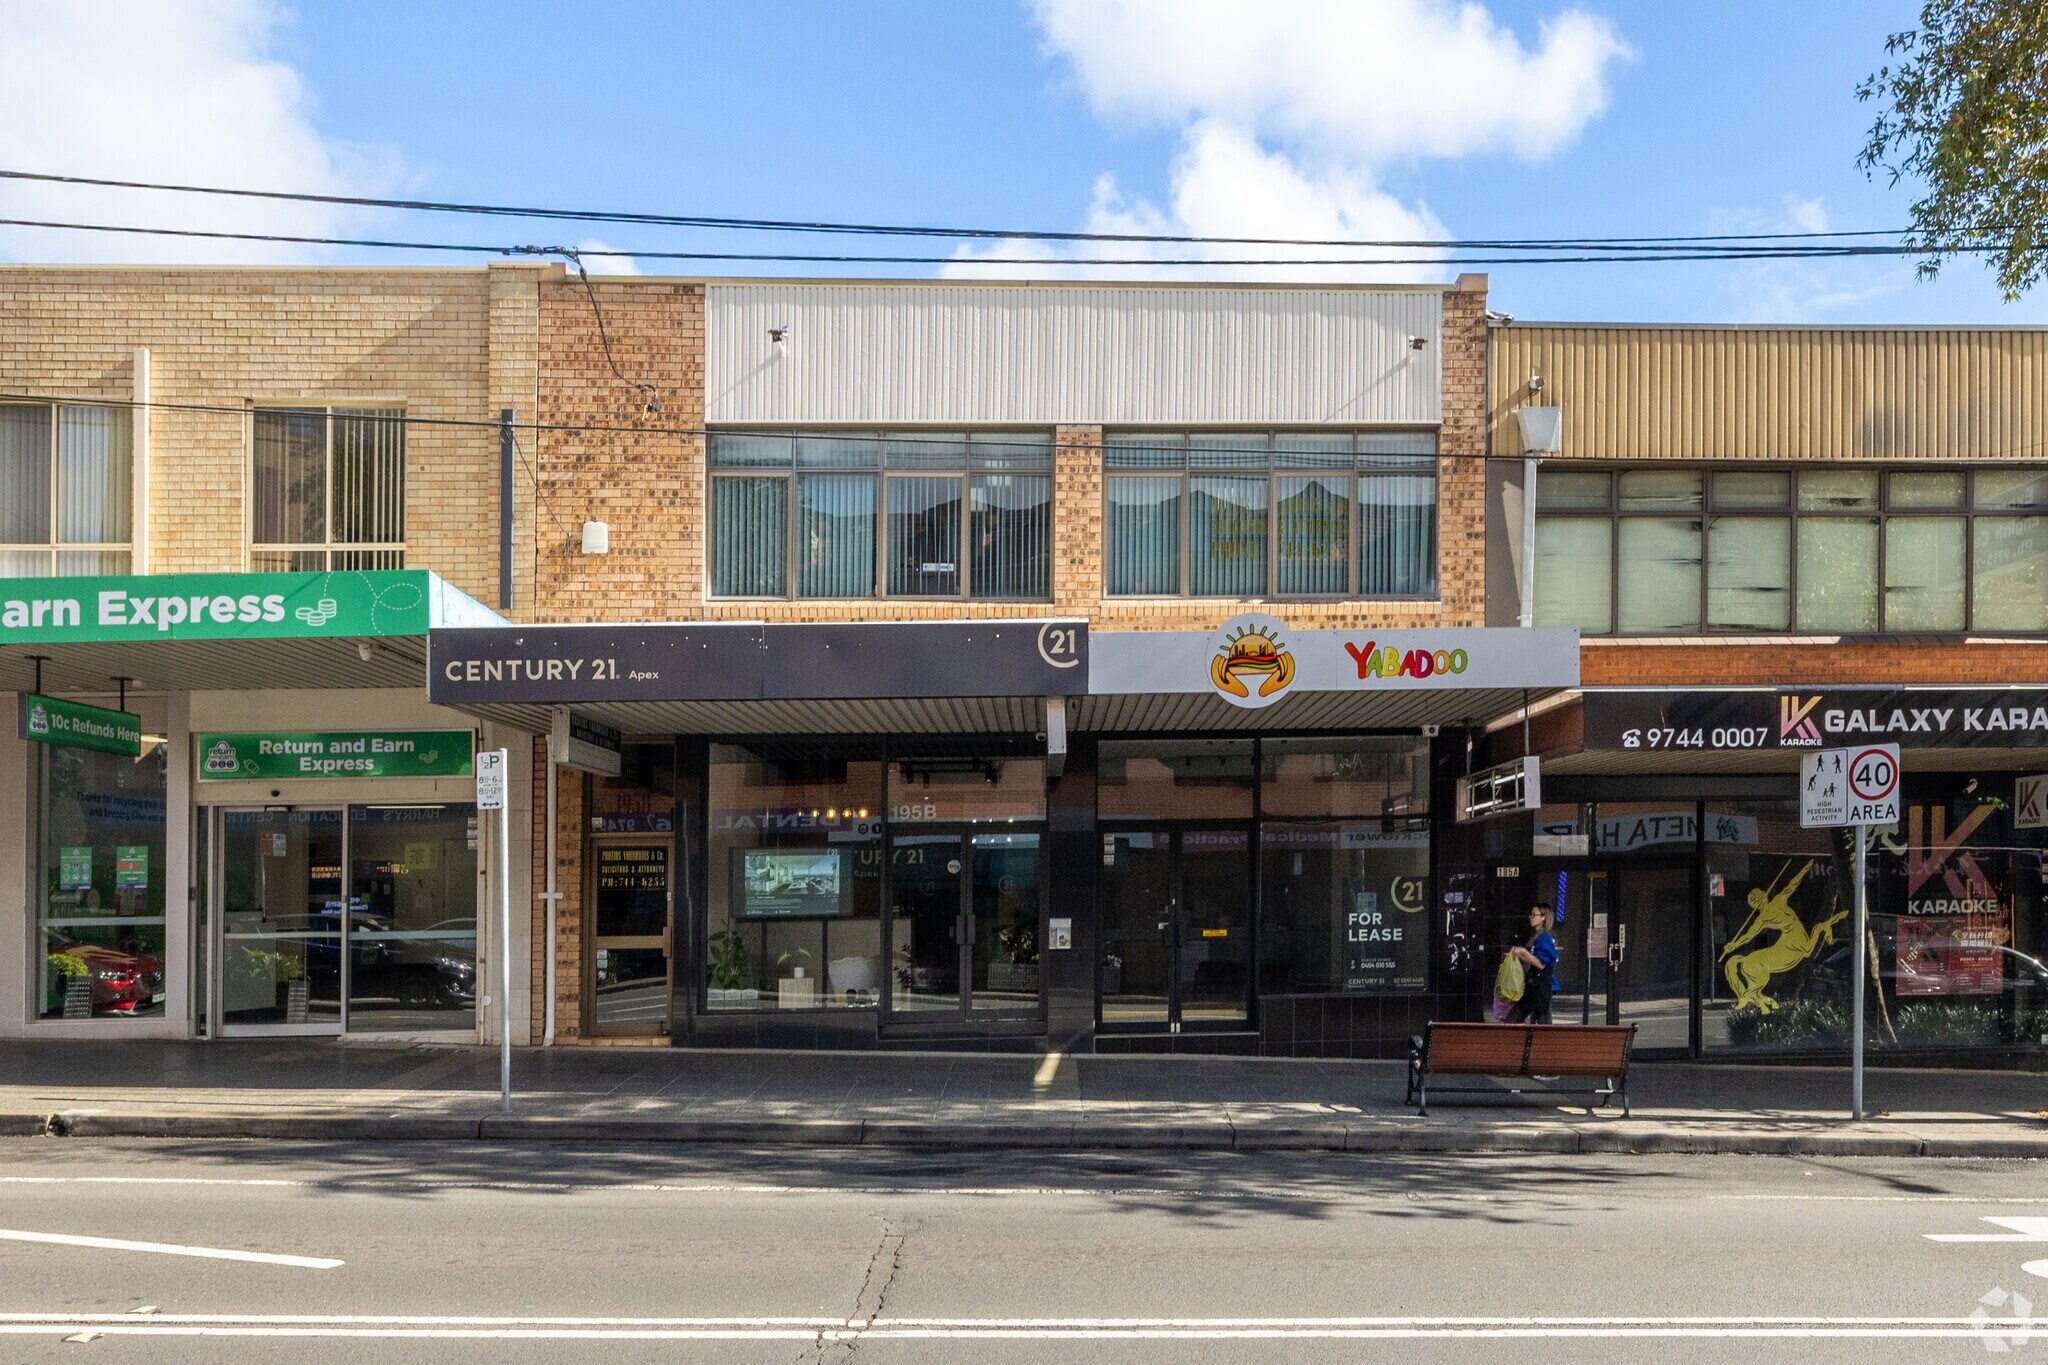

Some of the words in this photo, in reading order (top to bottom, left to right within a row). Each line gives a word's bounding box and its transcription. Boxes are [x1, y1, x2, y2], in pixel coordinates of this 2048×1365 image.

[1, 598, 81, 628] arn
[98, 590, 286, 632] Express
[1344, 640, 1469, 680] YABADOO
[445, 658, 584, 682] CENTURY
[628, 669, 659, 681] Apex
[50, 713, 70, 731] 10c
[72, 717, 115, 739] Refunds
[117, 726, 140, 743] Here
[1825, 708, 1954, 733] GALAXY
[1963, 707, 2048, 732] KARA
[1647, 727, 1704, 748] 9744
[1711, 727, 1768, 747] 0007
[1780, 738, 1823, 746] KARAOKE
[209, 747, 234, 756] return
[259, 740, 324, 755] Return
[329, 738, 365, 753] and
[371, 738, 415, 752] Earn
[299, 757, 374, 773] Express
[1855, 762, 1891, 787] 40
[893, 804, 937, 820] 195B
[1807, 807, 1843, 815] PEDESTRIAN
[1850, 803, 1897, 821] AREA
[907, 849, 924, 864] 21
[638, 865, 665, 873] ATTORNEYS
[1908, 898, 1998, 914] KARAOKE
[1348, 912, 1382, 925] FOR
[1348, 928, 1403, 941] LEASE
